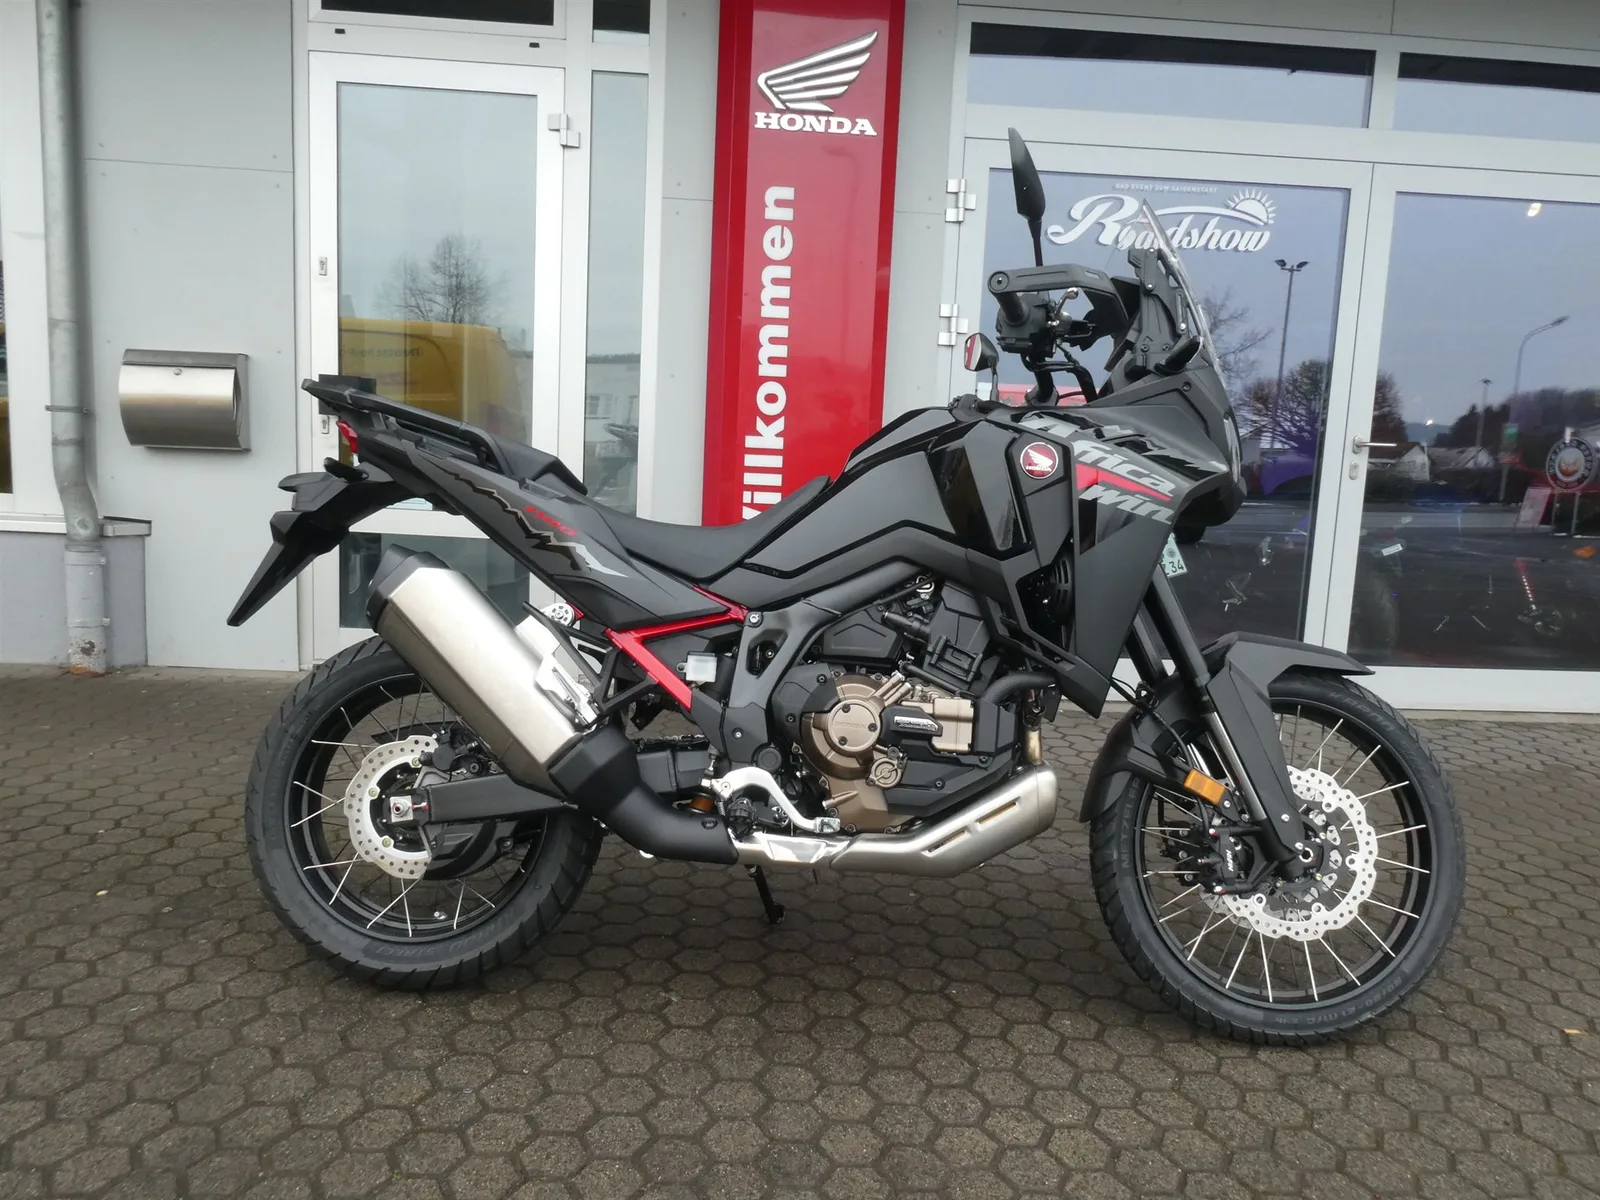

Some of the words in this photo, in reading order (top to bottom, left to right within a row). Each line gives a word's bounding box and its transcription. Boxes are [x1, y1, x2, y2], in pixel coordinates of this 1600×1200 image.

[754, 112, 878, 136] HONDA
[1047, 193, 1271, 252] Roadshow
[1119, 776, 1141, 870] METZELER
